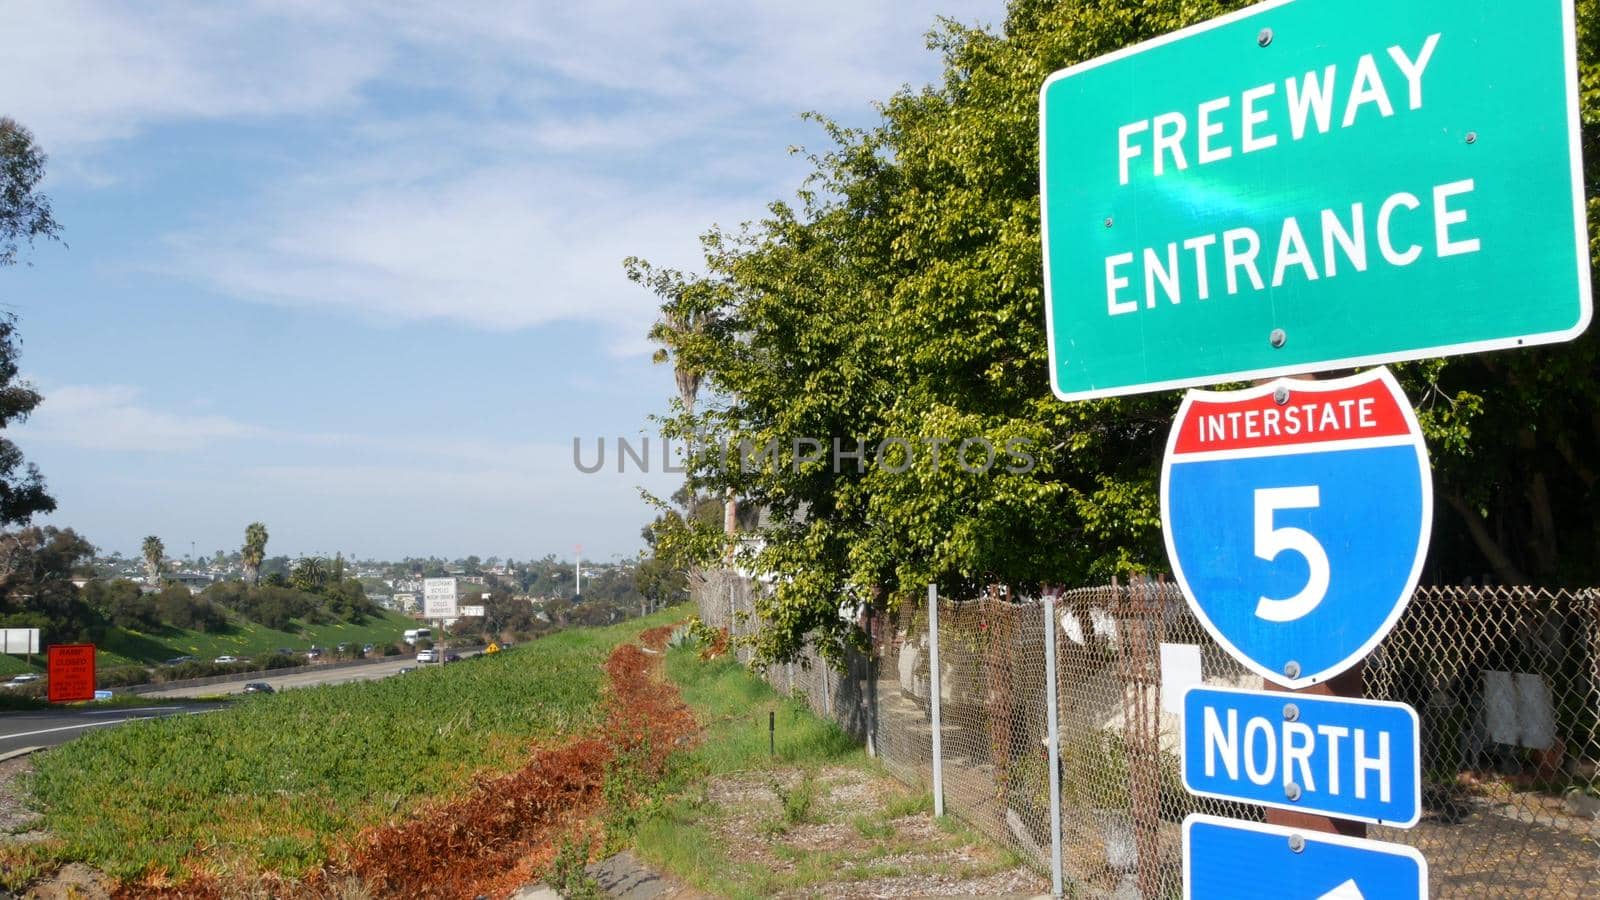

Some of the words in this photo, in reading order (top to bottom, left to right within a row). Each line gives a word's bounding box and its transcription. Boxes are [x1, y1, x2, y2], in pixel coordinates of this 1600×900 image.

[1118, 33, 1441, 185] FREEWAY
[1105, 178, 1481, 316] ENTRANCE
[1199, 398, 1377, 442] INTERSTATE
[1254, 485, 1330, 622] 5
[1203, 706, 1391, 802] NORTH
